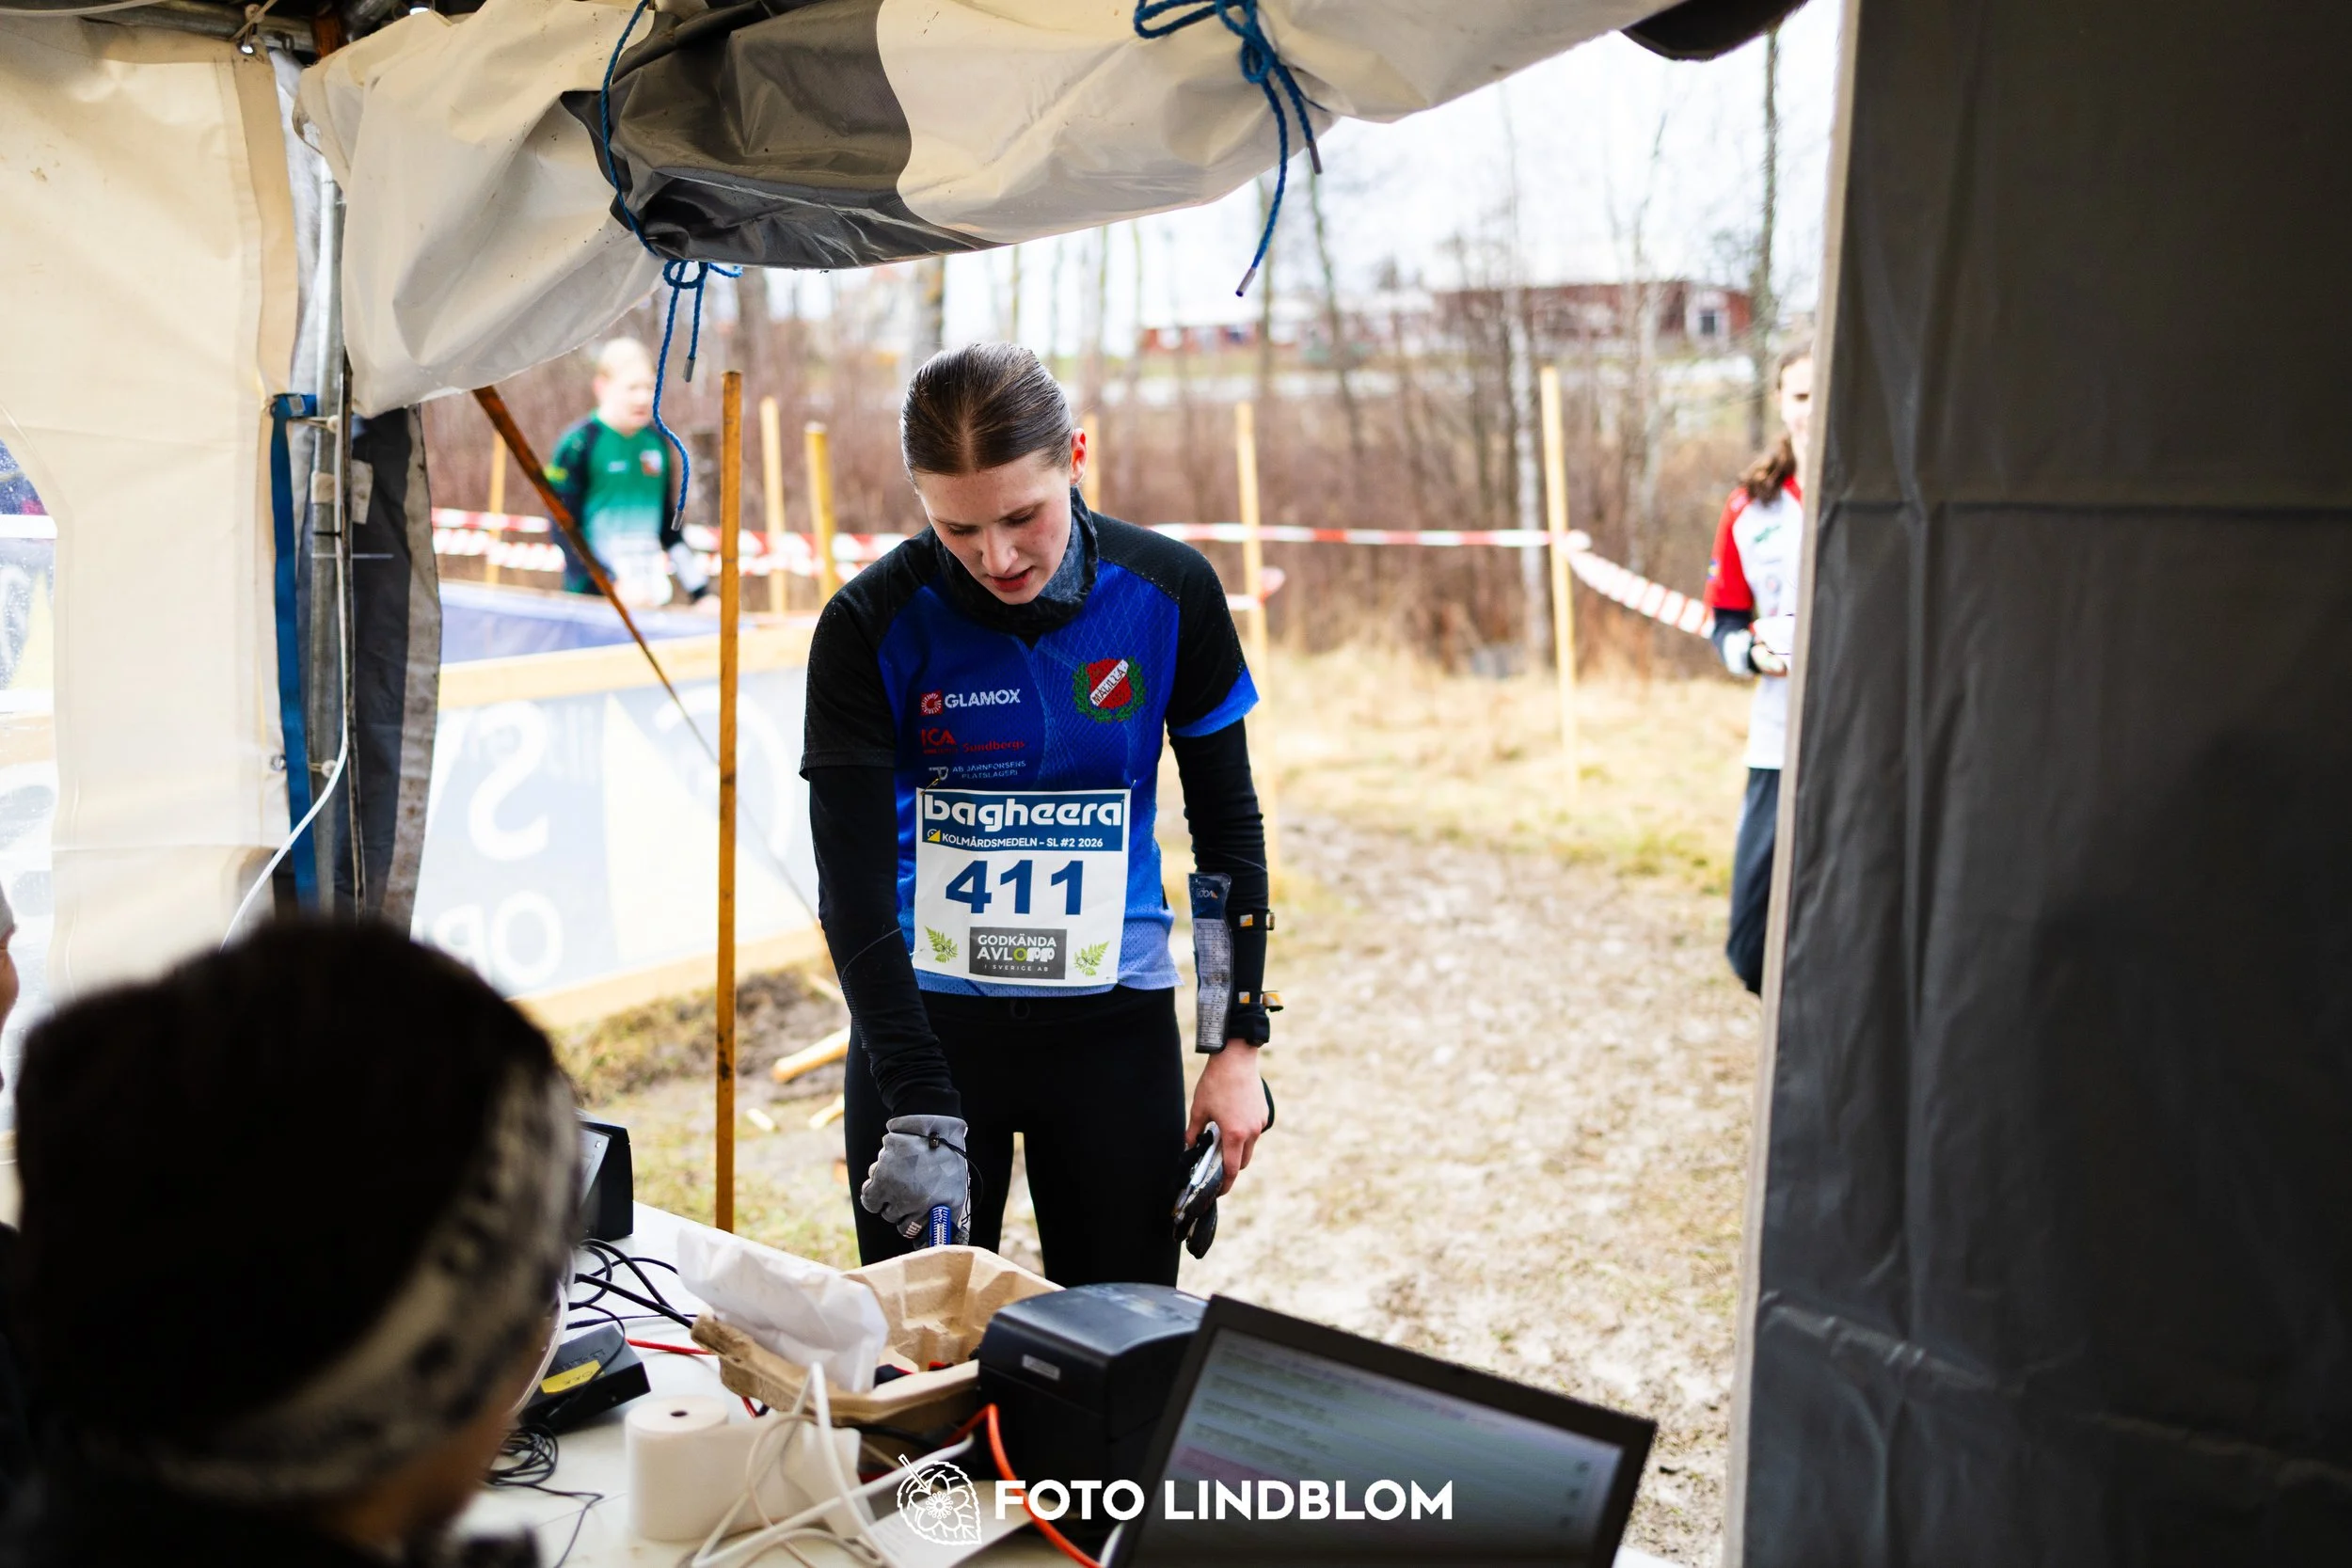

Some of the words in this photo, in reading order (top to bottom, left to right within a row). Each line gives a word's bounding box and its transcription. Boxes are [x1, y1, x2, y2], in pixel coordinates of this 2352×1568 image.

[945, 689, 1021, 708] GLAMOX
[920, 728, 957, 747] ICA
[924, 795, 1123, 832] bagheera
[942, 832, 1038, 847] KOLMÅRDSMEDELN
[1046, 838, 1058, 847] SL
[1060, 838, 1075, 847] #2
[1078, 837, 1104, 847] 2026
[946, 860, 1084, 915] 411
[977, 933, 1057, 947] GODKÄNDA
